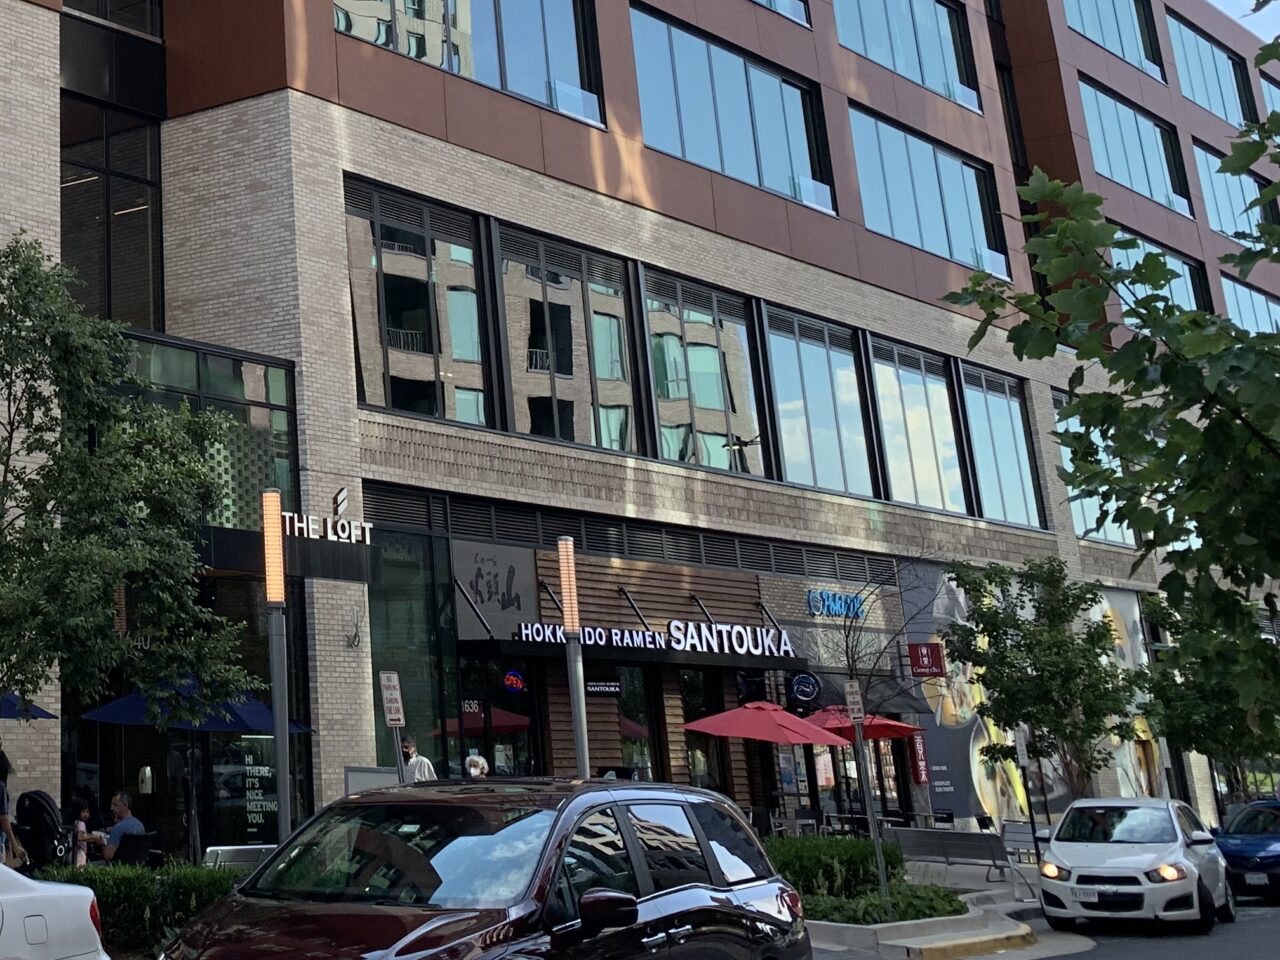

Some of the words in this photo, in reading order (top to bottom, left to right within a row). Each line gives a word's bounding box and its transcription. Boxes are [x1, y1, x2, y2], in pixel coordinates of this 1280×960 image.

[281, 511, 320, 540] THE
[326, 517, 374, 545] LOFT
[521, 622, 606, 646] HOKKIDO
[612, 628, 666, 649] RAMEN
[670, 619, 796, 658] SANTOUKA
[505, 675, 522, 688] OPEN
[461, 699, 479, 712] 1636
[245, 754, 254, 765] HI
[245, 766, 272, 778] THERE,
[245, 778, 260, 789] IT'S
[246, 790, 264, 800] NICE
[246, 801, 279, 812] MEETING
[247, 813, 265, 824] YOU.
